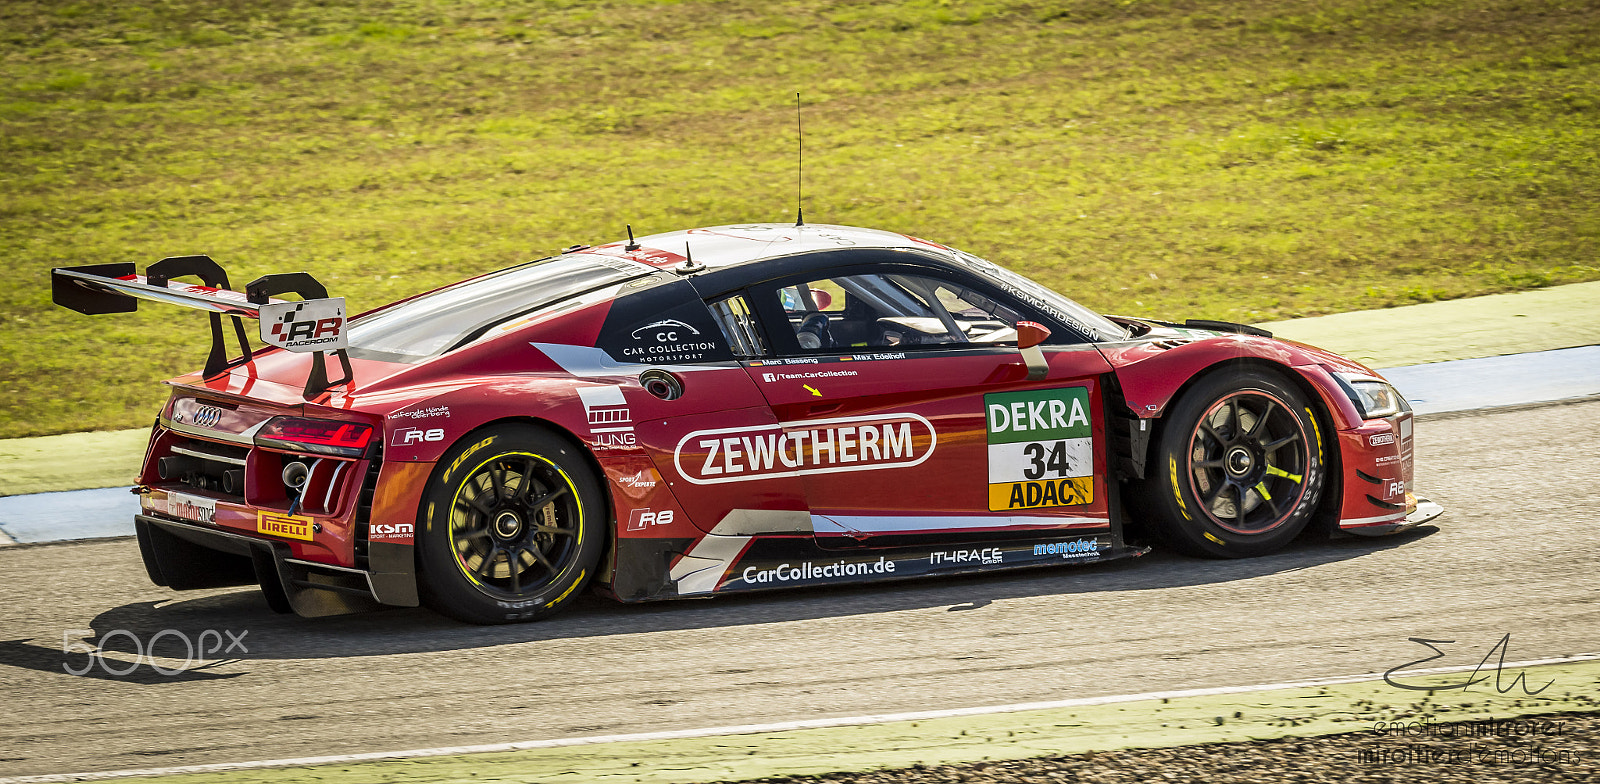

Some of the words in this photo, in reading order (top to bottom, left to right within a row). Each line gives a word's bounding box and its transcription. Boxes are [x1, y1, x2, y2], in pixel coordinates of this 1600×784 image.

[1000, 283, 1099, 341] #KSMCARDESIGN
[287, 317, 342, 341] RR
[656, 331, 678, 342] CC
[286, 337, 338, 347] RACEROOM
[623, 347, 645, 356] CAR
[648, 342, 715, 354] COLLECTION
[640, 353, 703, 363] MOTORSPORT
[988, 397, 1089, 433] DEKRA
[404, 428, 445, 443] R8
[591, 433, 636, 447] JUNG
[1023, 441, 1070, 480] 34
[1008, 479, 1075, 509] ADAC
[262, 514, 307, 536] PIRELLI
[638, 510, 674, 527] R8
[370, 523, 414, 534] KSM
[1033, 538, 1098, 556] memotec
[743, 556, 895, 584] CarCollection.de
